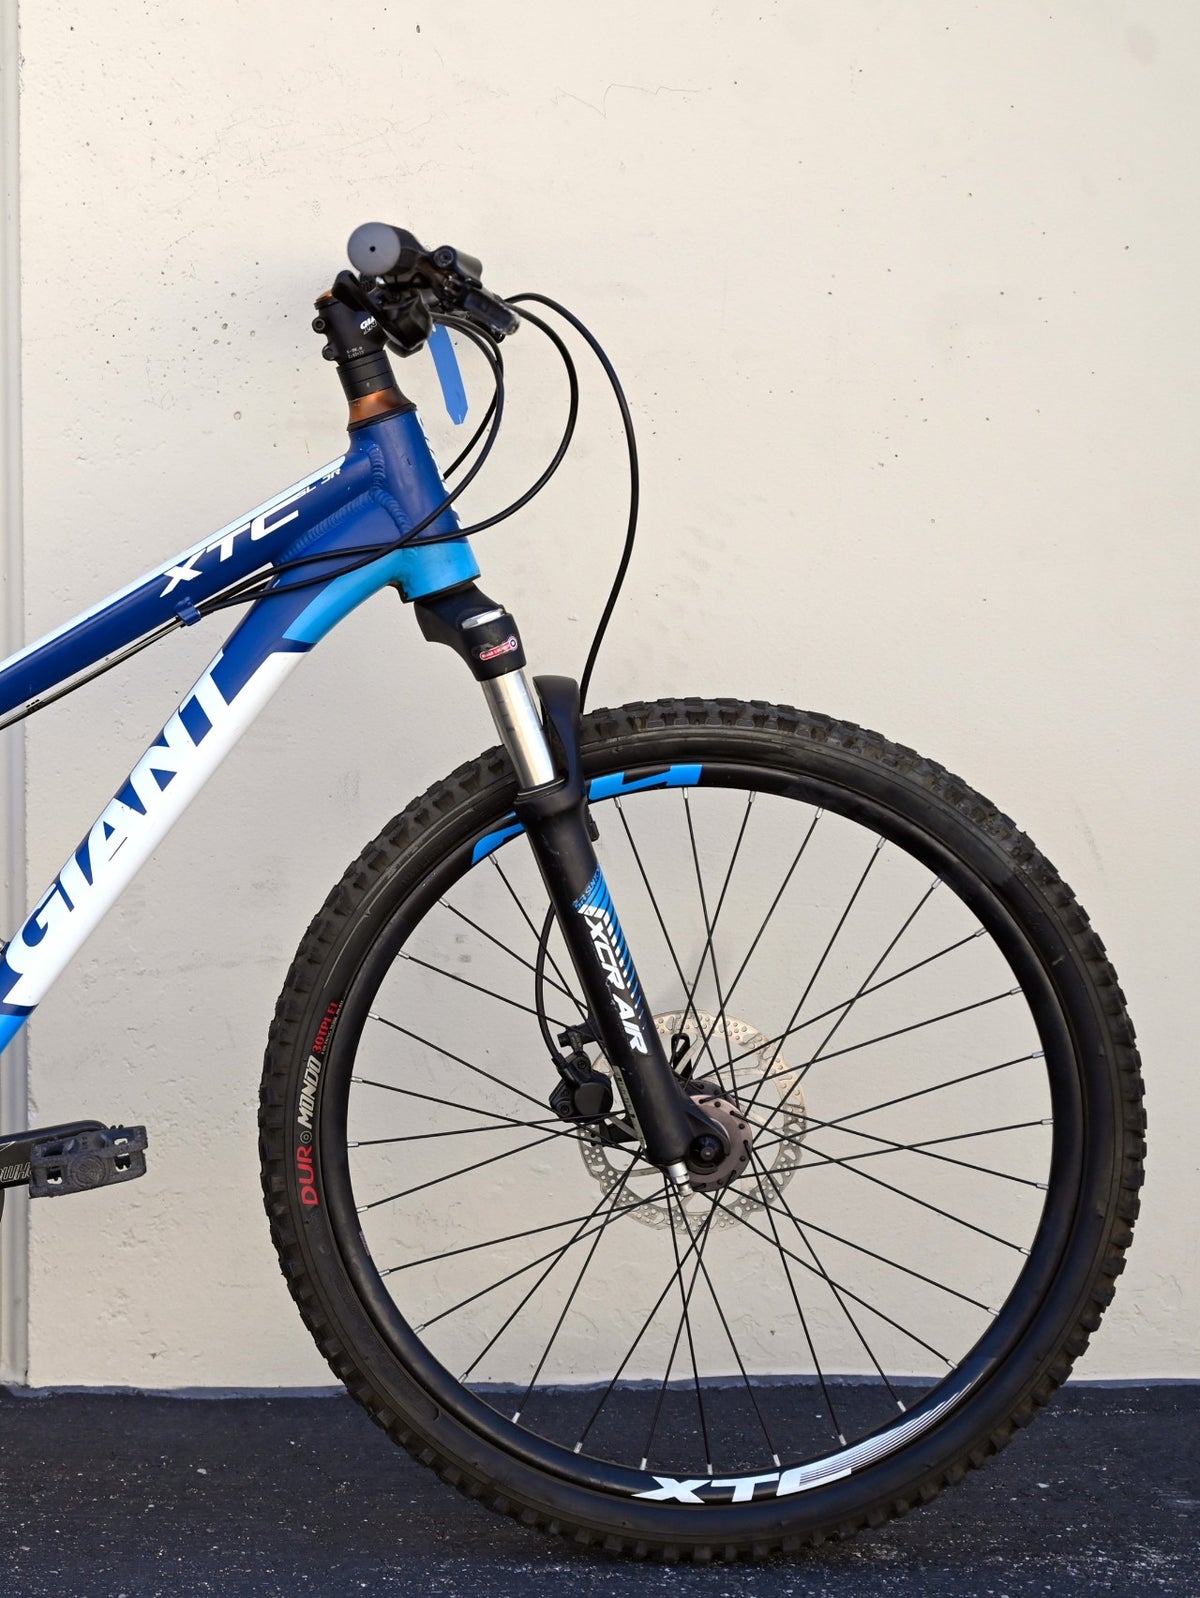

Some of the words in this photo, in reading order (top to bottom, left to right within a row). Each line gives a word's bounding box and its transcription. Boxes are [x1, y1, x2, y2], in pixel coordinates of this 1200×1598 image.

[160, 493, 302, 598] XTC
[5, 649, 240, 980] GIANT
[583, 915, 626, 991] XCR
[612, 993, 649, 1055] AIR
[296, 1054, 323, 1130] MONDO
[631, 1463, 852, 1504] XTC
